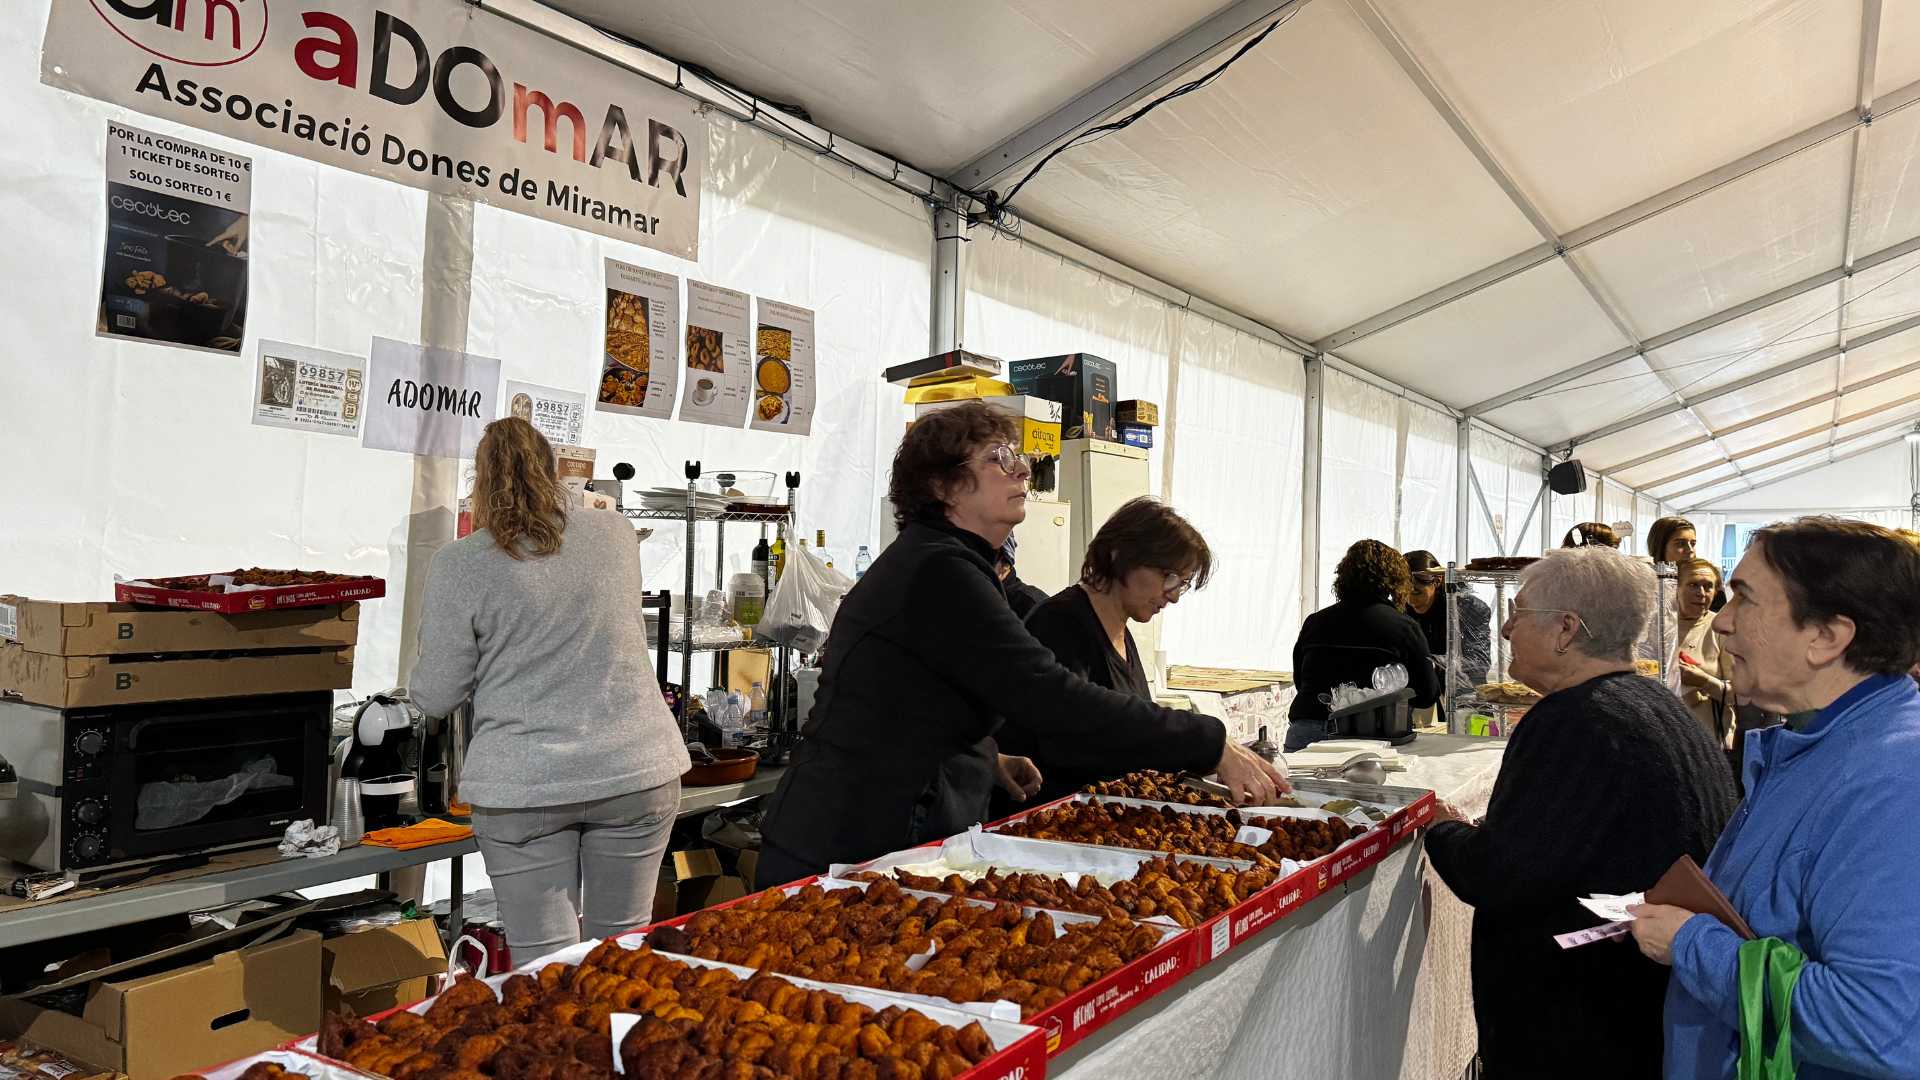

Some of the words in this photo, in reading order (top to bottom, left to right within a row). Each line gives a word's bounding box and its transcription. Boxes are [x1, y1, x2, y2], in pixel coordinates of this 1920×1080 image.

[294, 9, 688, 198] aDOmAR
[109, 126, 134, 142] POR
[137, 133, 152, 147] LA
[155, 139, 207, 161] COMPRA
[210, 152, 225, 165] DE
[228, 158, 241, 169] 10
[243, 162, 251, 172] €
[120, 145, 127, 155] 1
[129, 147, 173, 166] TICKET
[175, 159, 191, 171] DE
[194, 163, 240, 183] SORTEO
[135, 62, 371, 156] Associació
[381, 133, 491, 188] Dones
[499, 168, 538, 201] de
[546, 179, 660, 236] Miramar
[129, 169, 162, 185] SOLO
[165, 178, 213, 197] SORTEO
[215, 190, 221, 200] 1
[224, 192, 231, 202] €
[111, 195, 190, 225] cecotec
[299, 366, 345, 382] 69857
[387, 378, 482, 418] ADOMAR
[536, 400, 569, 414] 69857
[118, 622, 134, 640] B
[116, 672, 132, 690] B
[1144, 956, 1177, 985] CALIDAD
